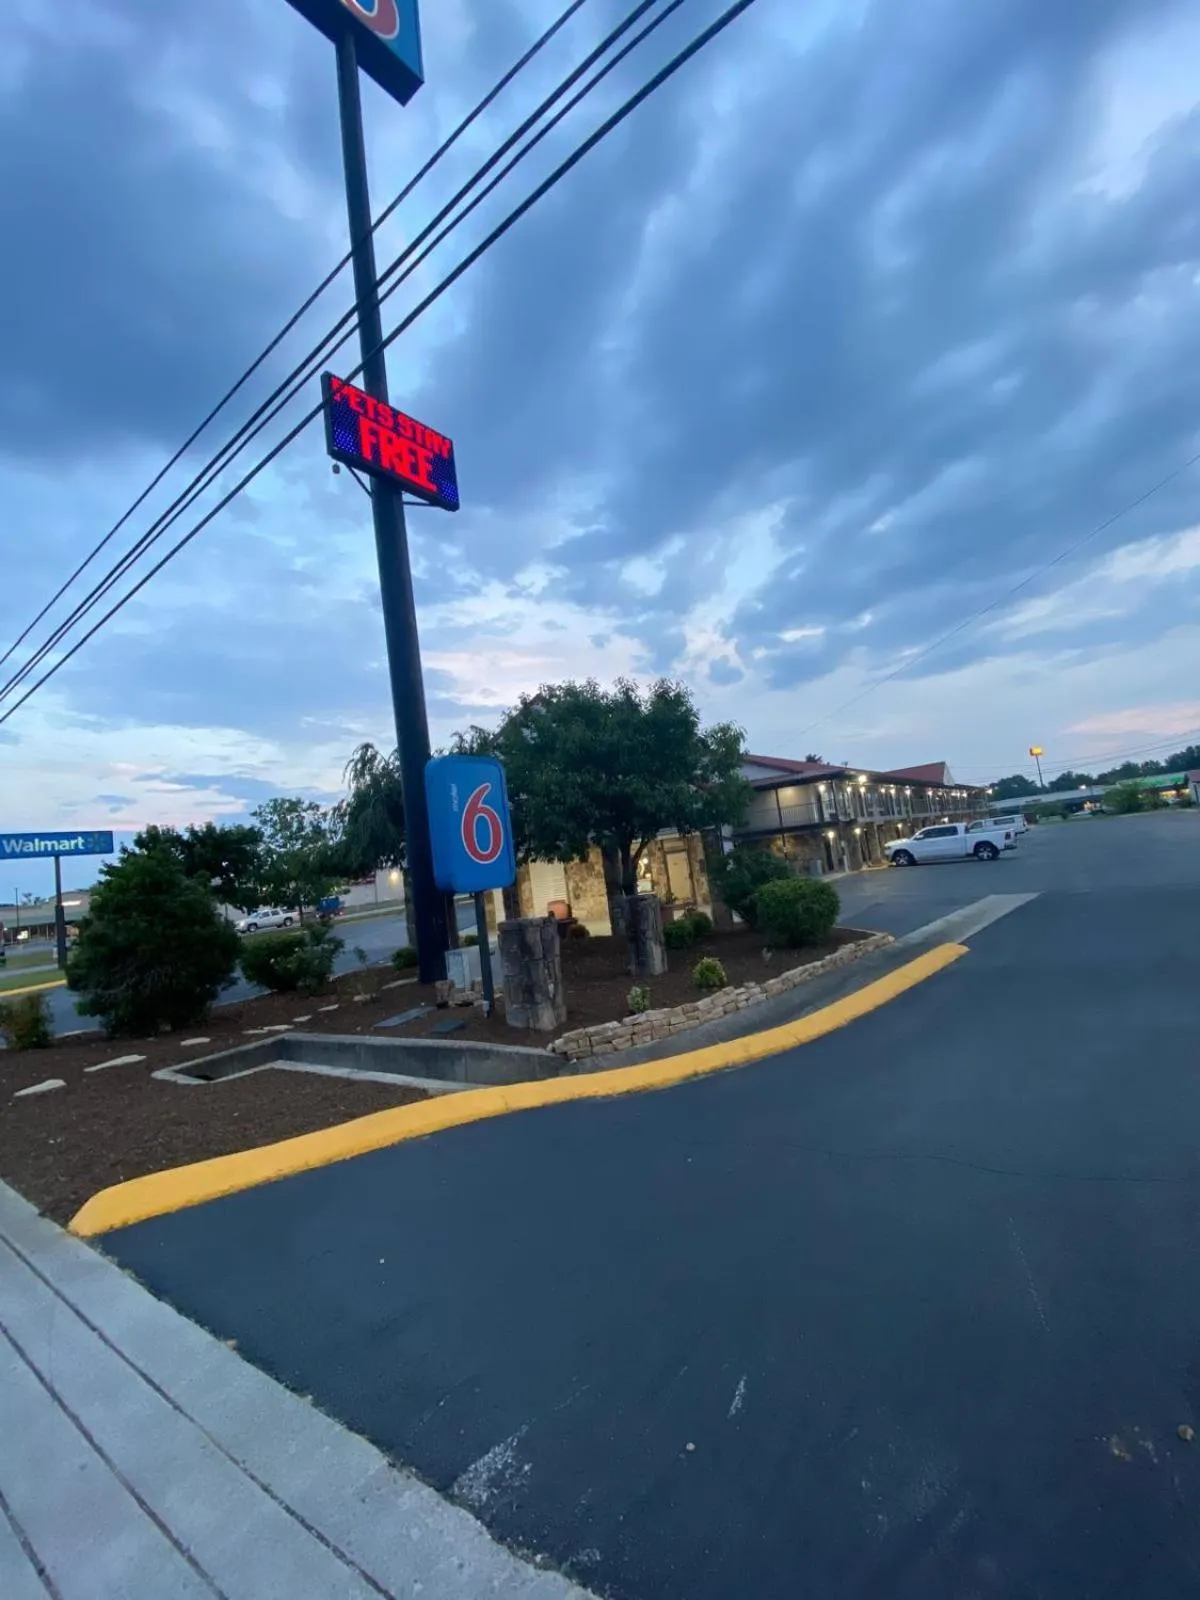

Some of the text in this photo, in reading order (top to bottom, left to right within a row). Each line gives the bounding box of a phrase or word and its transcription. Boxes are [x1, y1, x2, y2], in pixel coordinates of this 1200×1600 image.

[331, 377, 450, 458] PETS STAY
[359, 416, 437, 492] FREE
[2, 836, 85, 853] Walmart
[461, 782, 503, 864] 6
